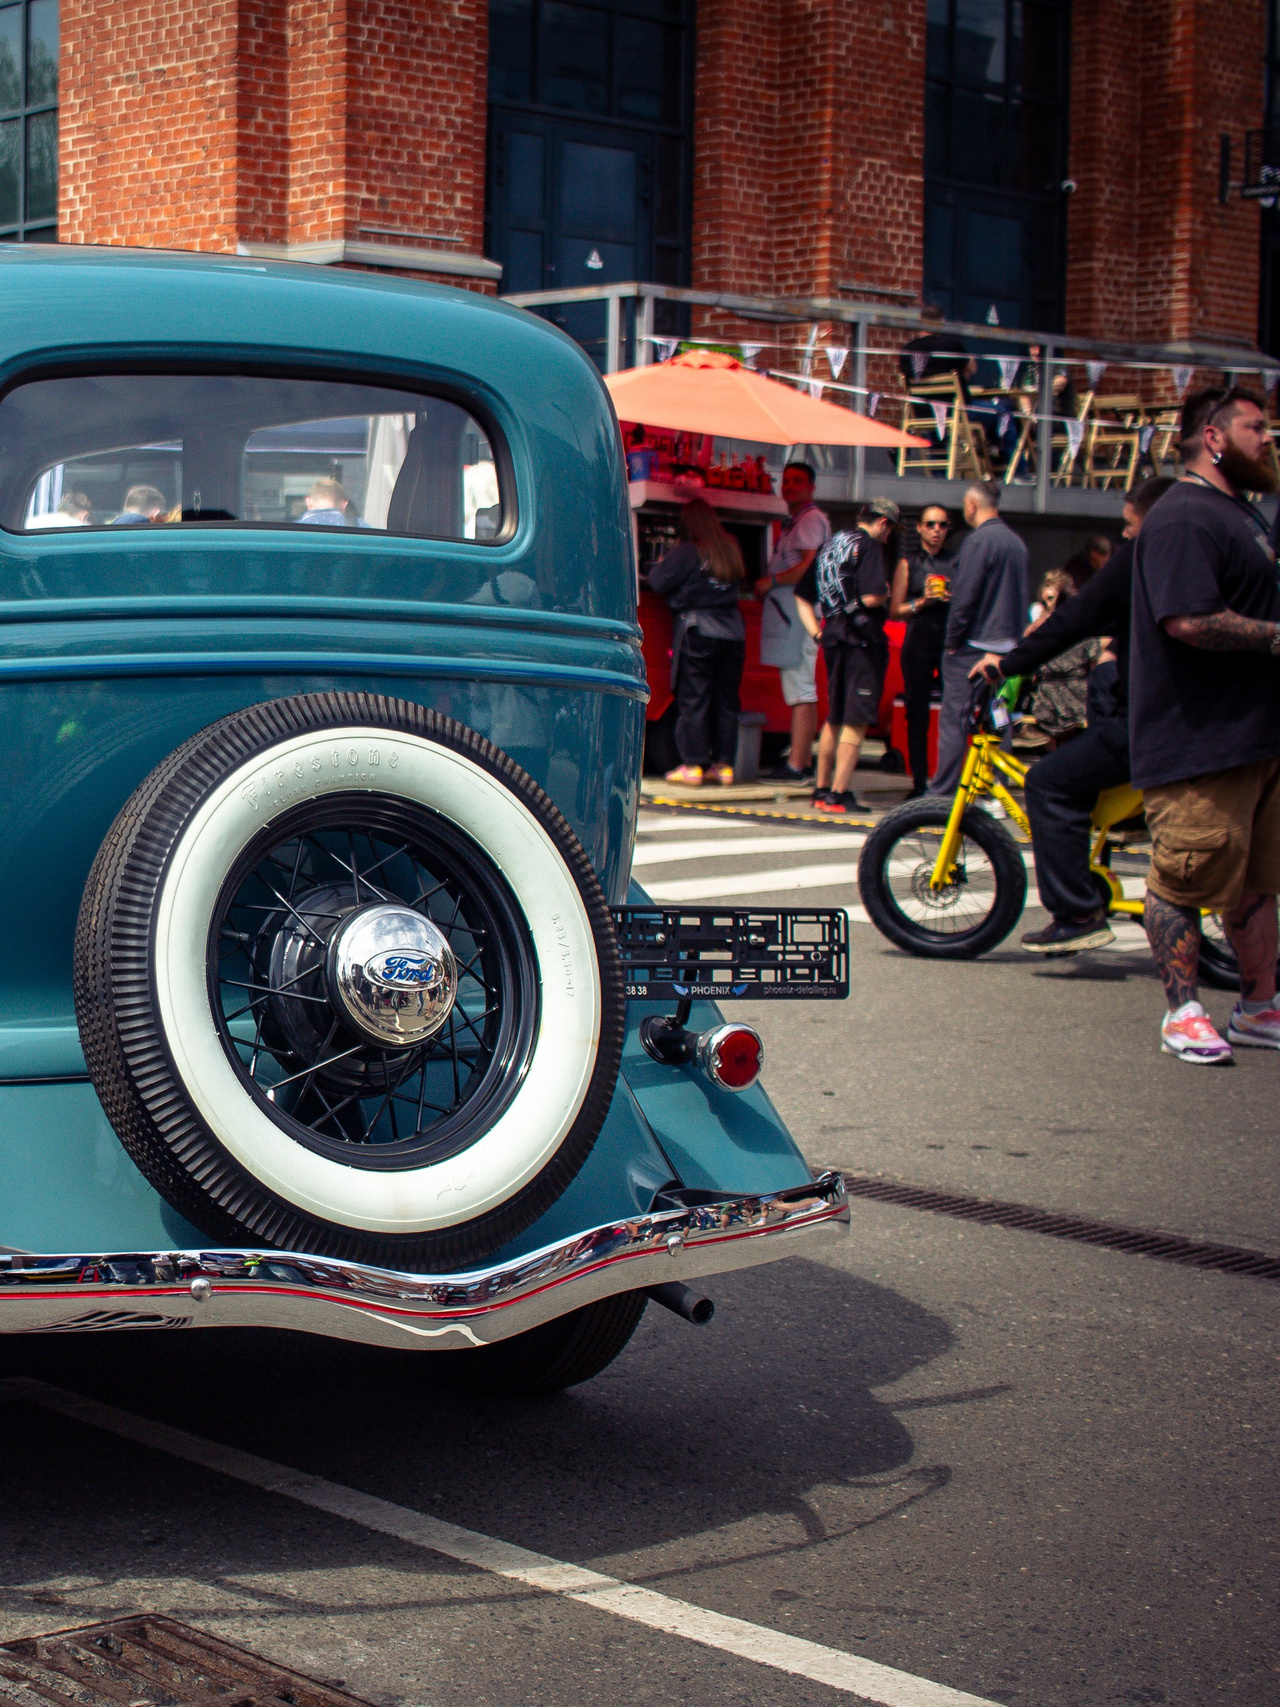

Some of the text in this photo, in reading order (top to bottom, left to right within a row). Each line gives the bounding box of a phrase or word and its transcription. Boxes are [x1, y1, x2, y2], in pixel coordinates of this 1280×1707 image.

[241, 748, 399, 812] Firestone
[382, 956, 434, 983] Ford
[626, 985, 837, 997] 38 38 PHOENIX phoenix-detailing.ru
